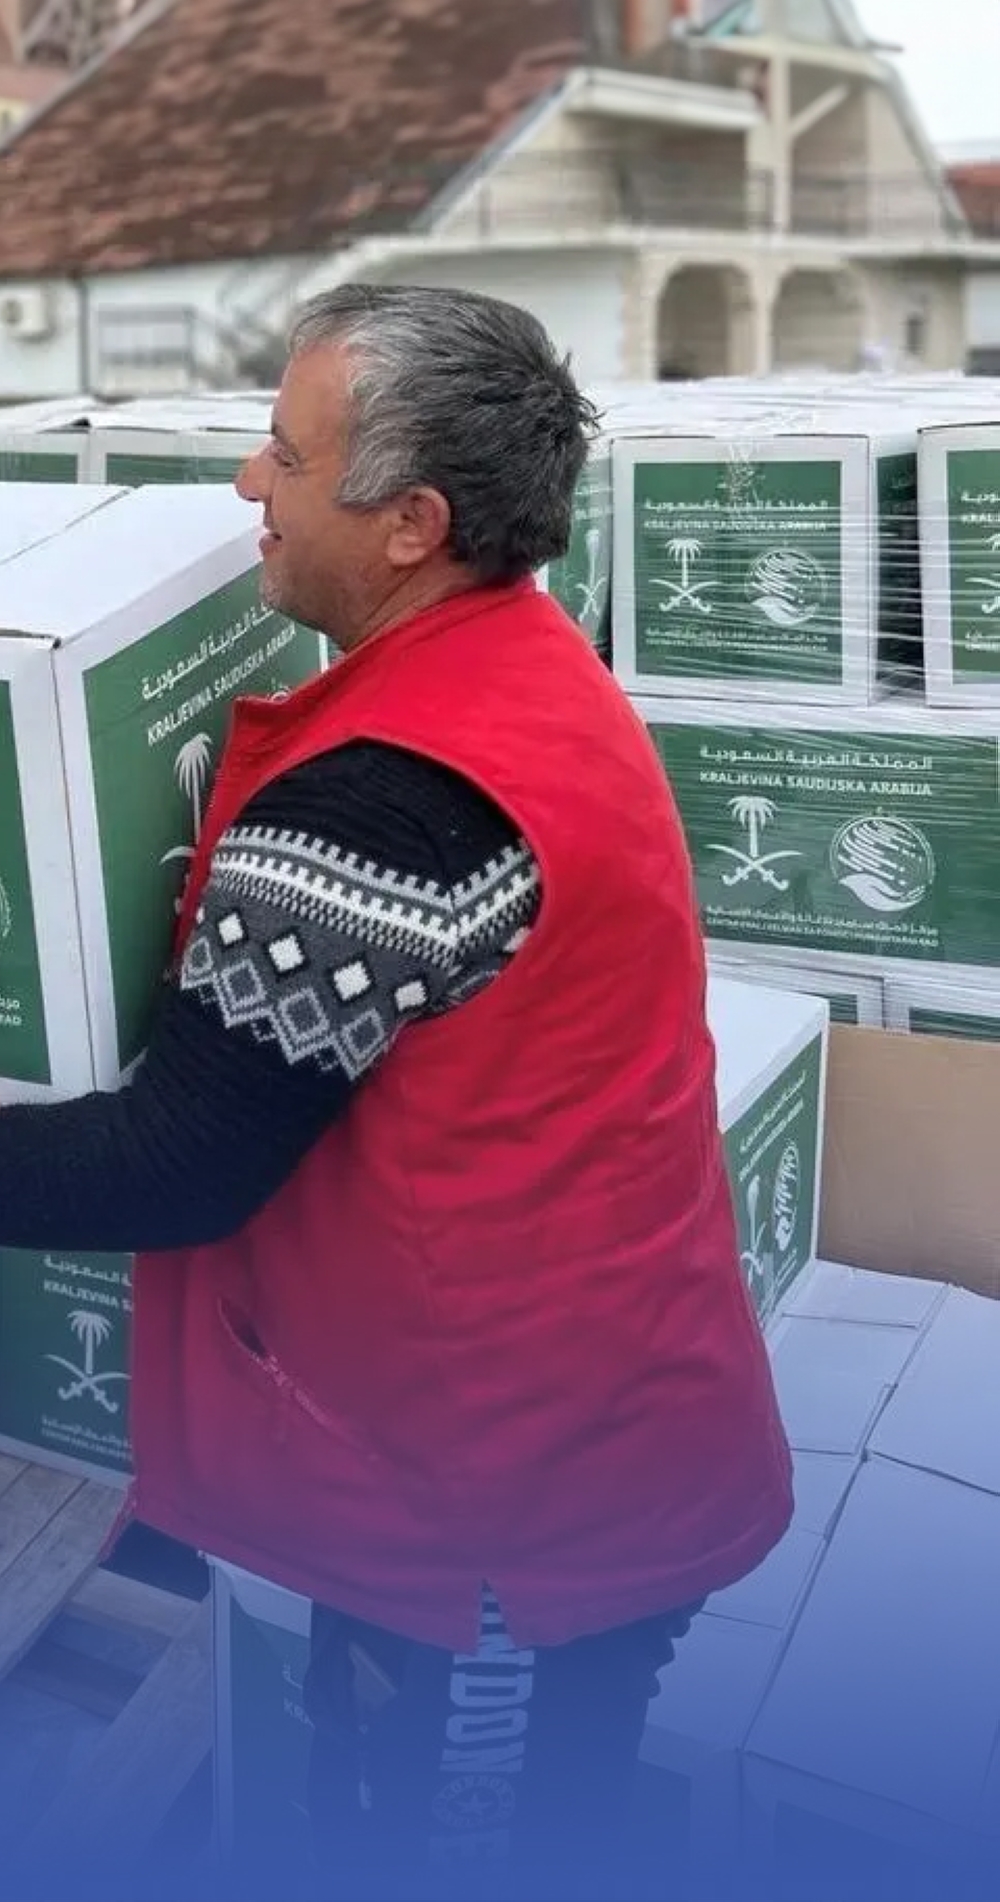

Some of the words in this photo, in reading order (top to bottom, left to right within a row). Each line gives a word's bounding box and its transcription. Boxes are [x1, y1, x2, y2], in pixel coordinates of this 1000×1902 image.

[148, 686, 213, 747] KRALJEVINA
[700, 771, 782, 787] KRALJEVINA
[787, 776, 865, 792] SAUDIJSKA
[869, 781, 932, 796] ARABIJA
